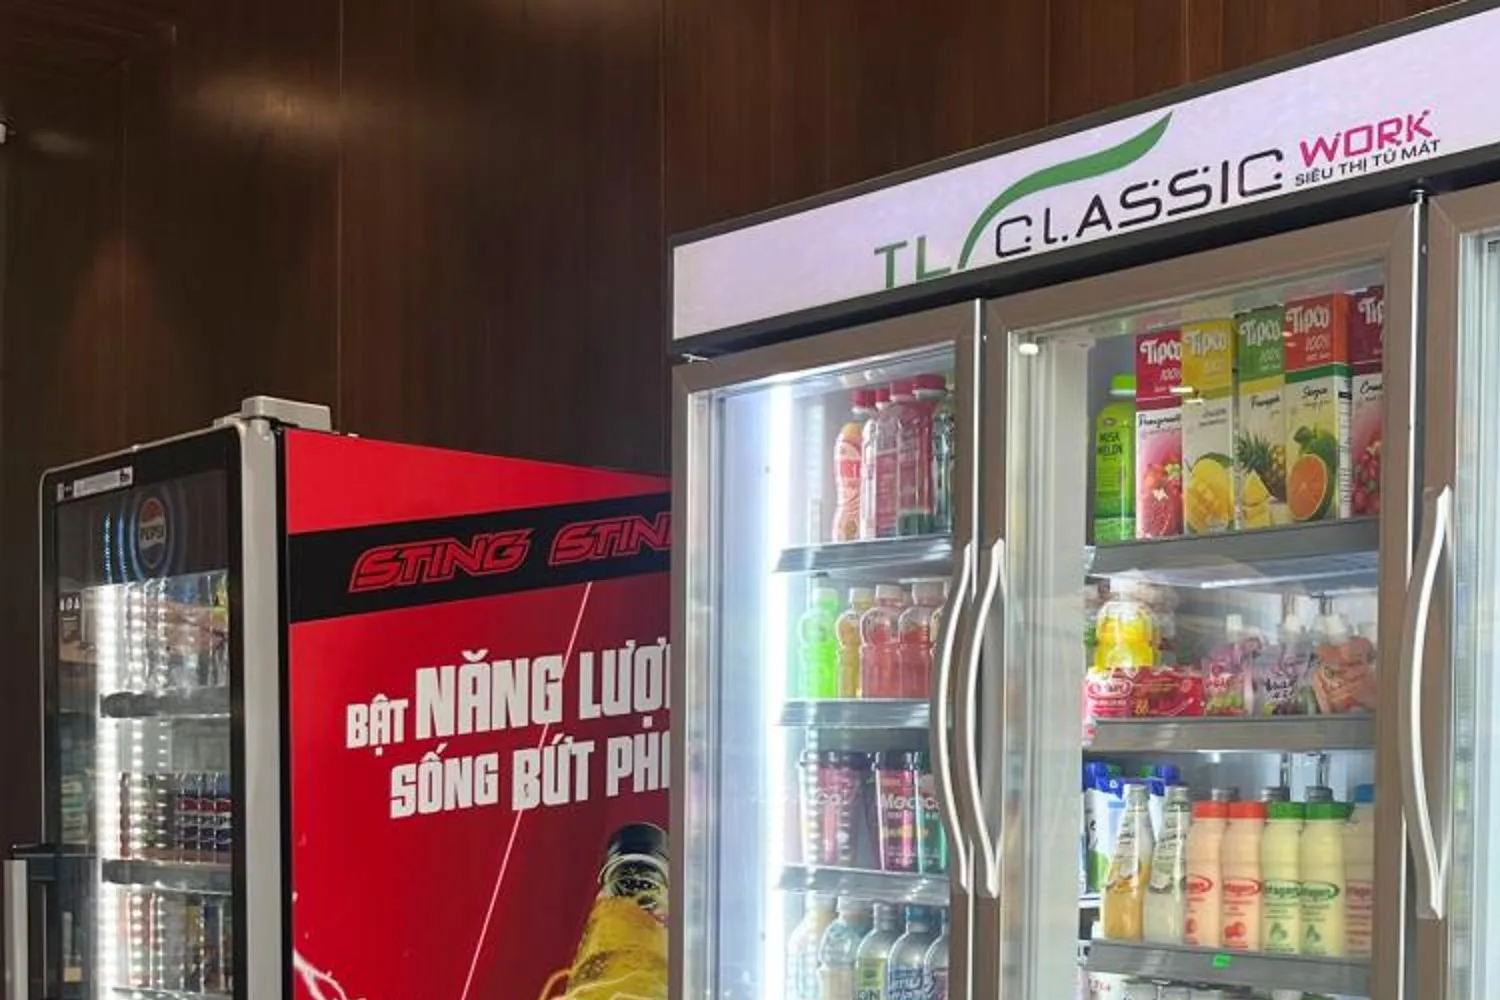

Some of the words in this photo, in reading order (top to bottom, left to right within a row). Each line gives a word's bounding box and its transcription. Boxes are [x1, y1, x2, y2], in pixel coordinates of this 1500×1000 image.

[1294, 162, 1334, 188] SIÊU
[1337, 153, 1369, 177] THỊ
[1400, 138, 1442, 161] MÁT
[1299, 108, 1434, 168] WORK
[993, 148, 1284, 259] CLASSIC
[1285, 303, 1330, 335] Tipco
[1357, 298, 1383, 325] Tip
[1140, 338, 1182, 365] Tipco
[348, 528, 535, 593] STING
[547, 512, 672, 567] STIN
[345, 693, 409, 757] BẬT
[414, 648, 563, 741] NĂNG
[578, 636, 671, 729] LƯỢ
[389, 742, 499, 820] SỐNG
[511, 732, 595, 812] BỨT
[605, 730, 671, 798] PH
